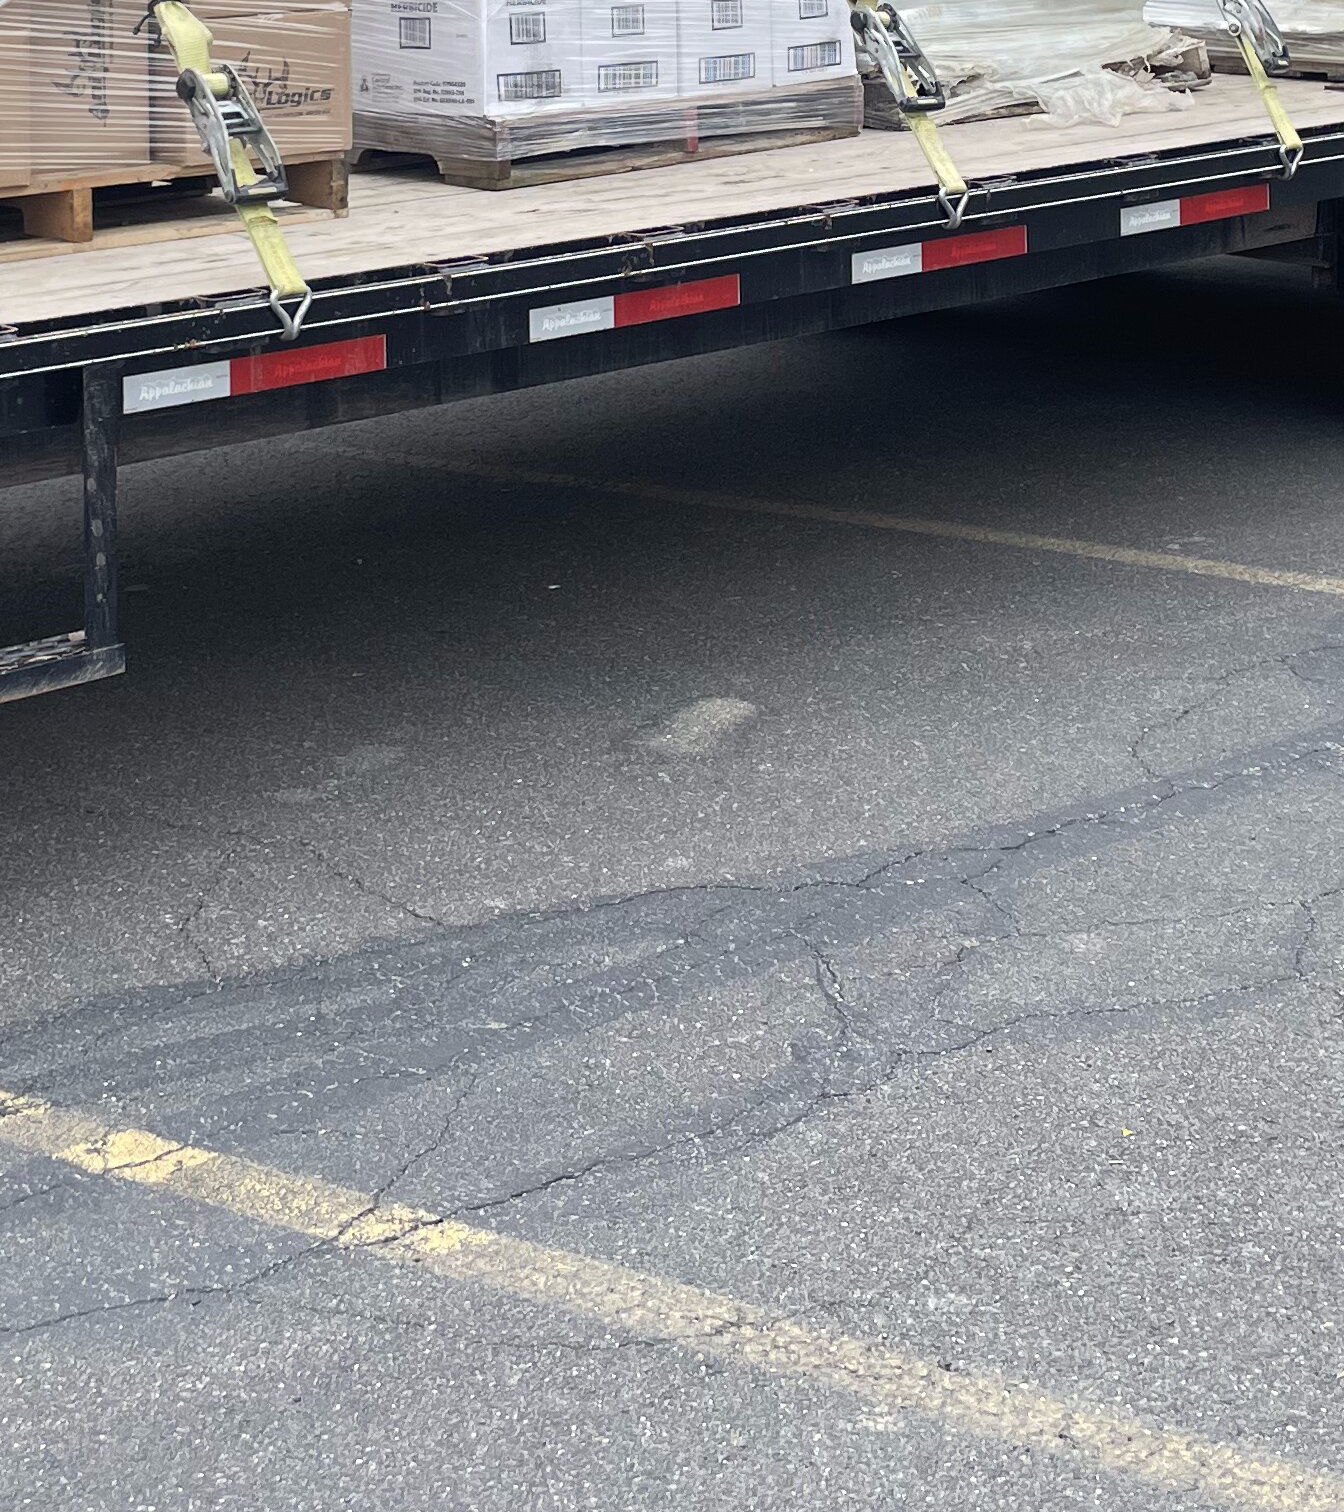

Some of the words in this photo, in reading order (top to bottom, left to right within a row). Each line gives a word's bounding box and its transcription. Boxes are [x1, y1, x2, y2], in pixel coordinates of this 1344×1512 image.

[266, 88, 332, 107] Logics
[542, 310, 602, 332] Appalachian
[274, 355, 342, 378] Appalachian
[139, 376, 214, 402] Appalachian
